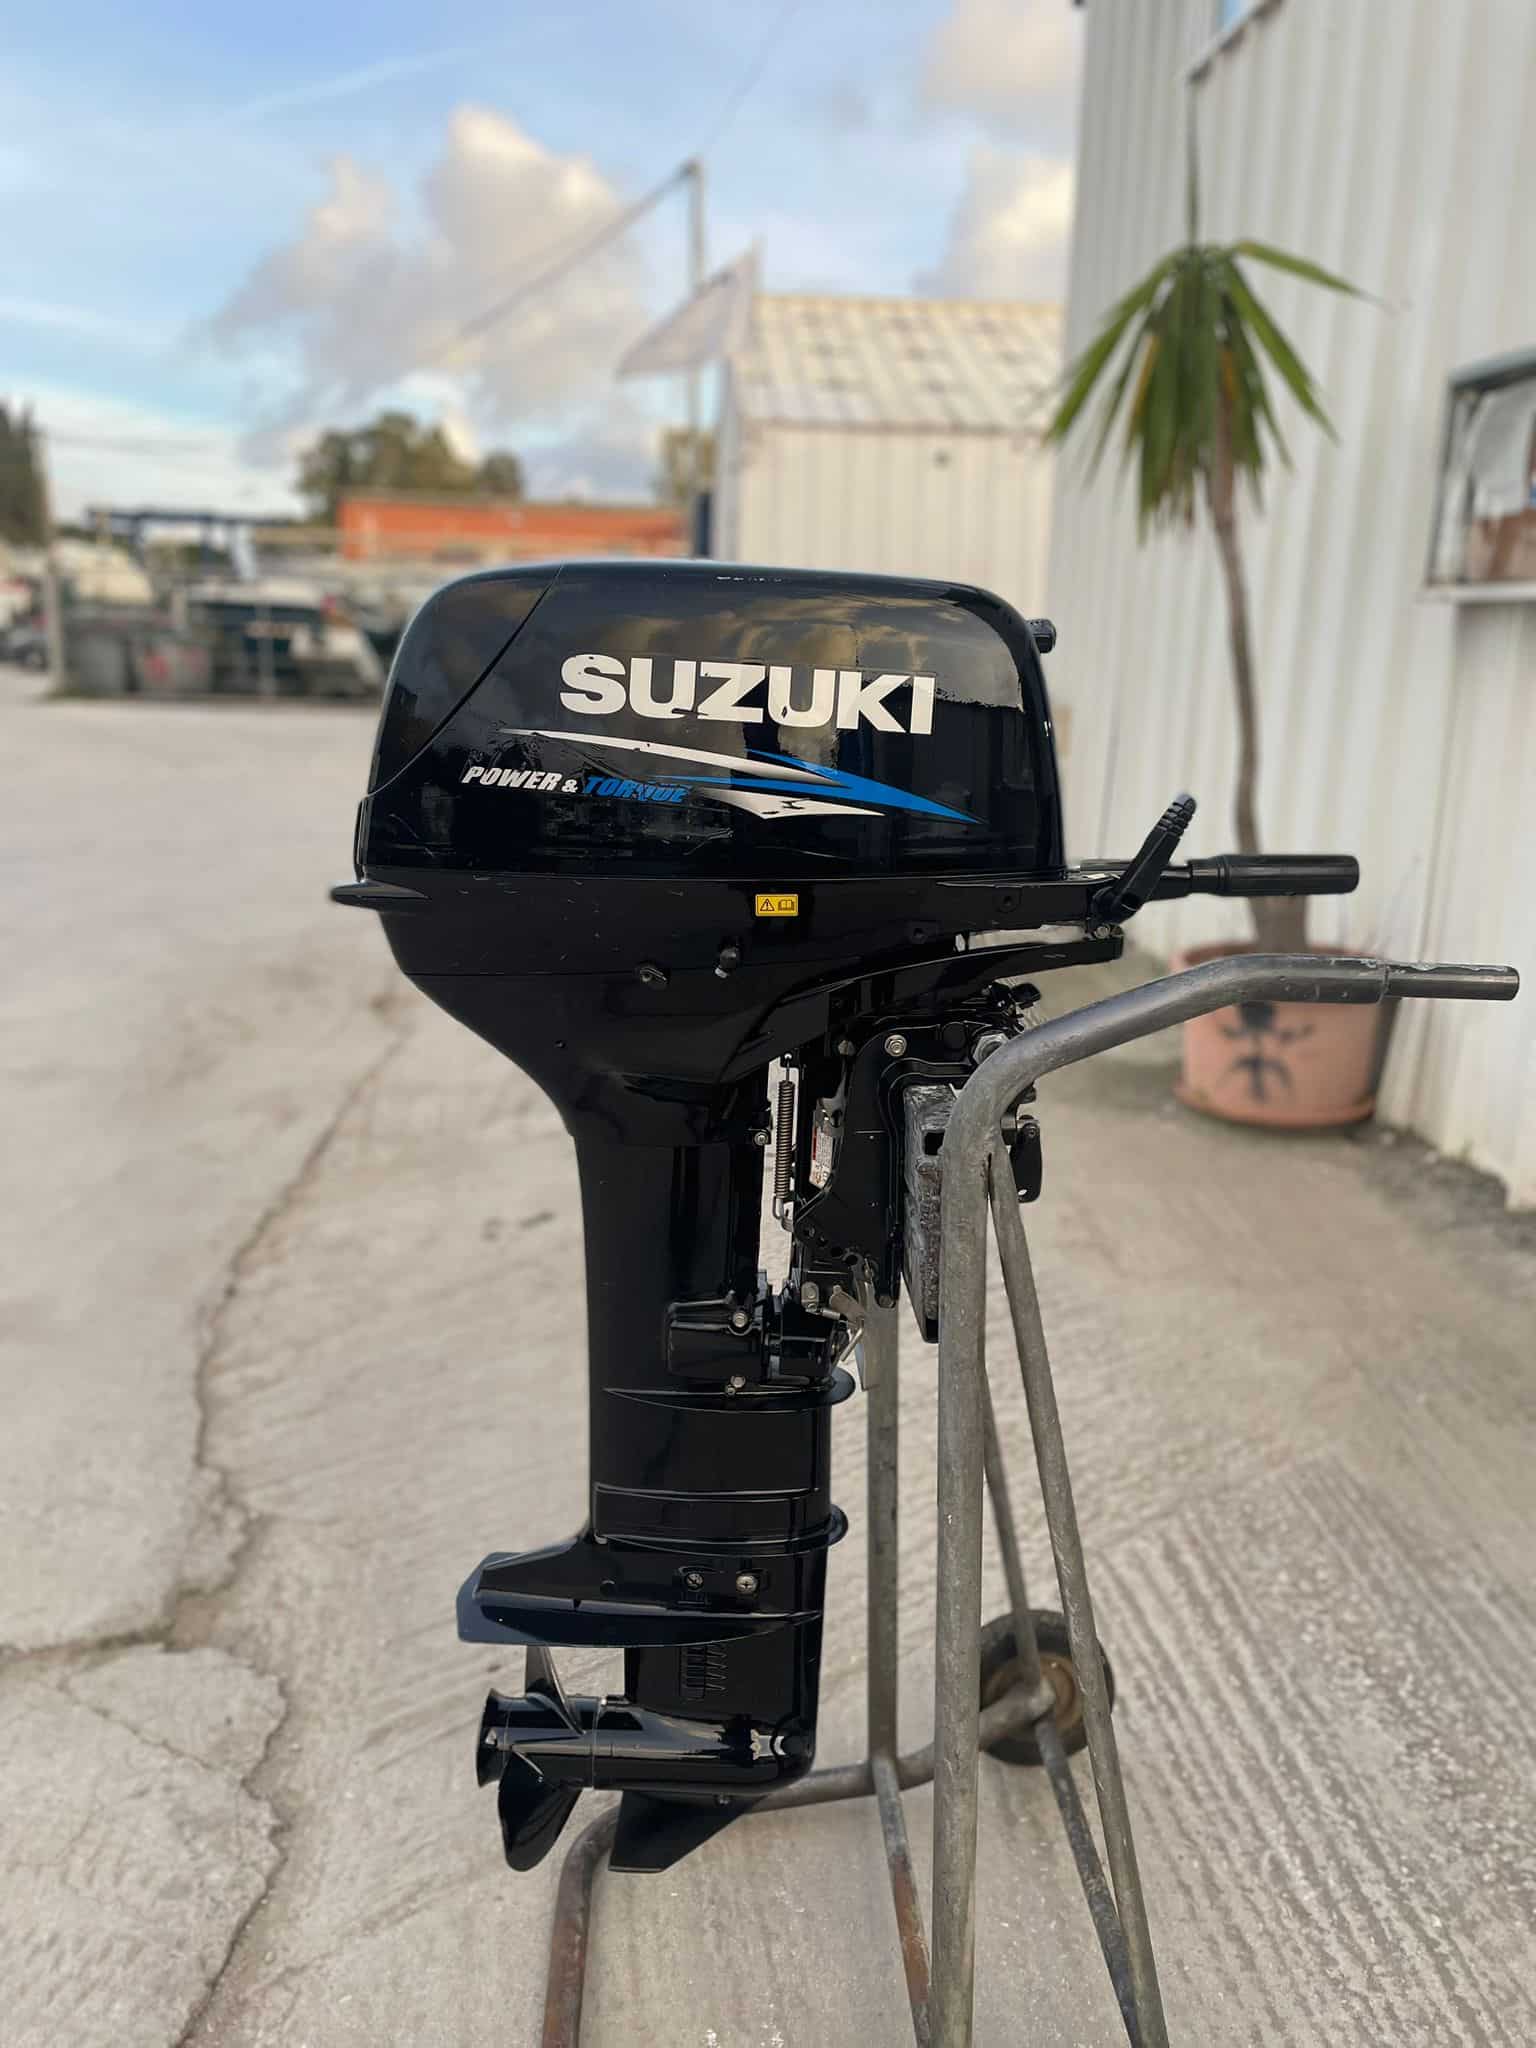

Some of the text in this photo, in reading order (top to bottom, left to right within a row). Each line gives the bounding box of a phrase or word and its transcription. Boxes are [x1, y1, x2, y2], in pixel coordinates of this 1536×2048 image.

[559, 653, 936, 735] SUZUKI
[461, 766, 563, 791] POWER
[562, 779, 578, 793] &
